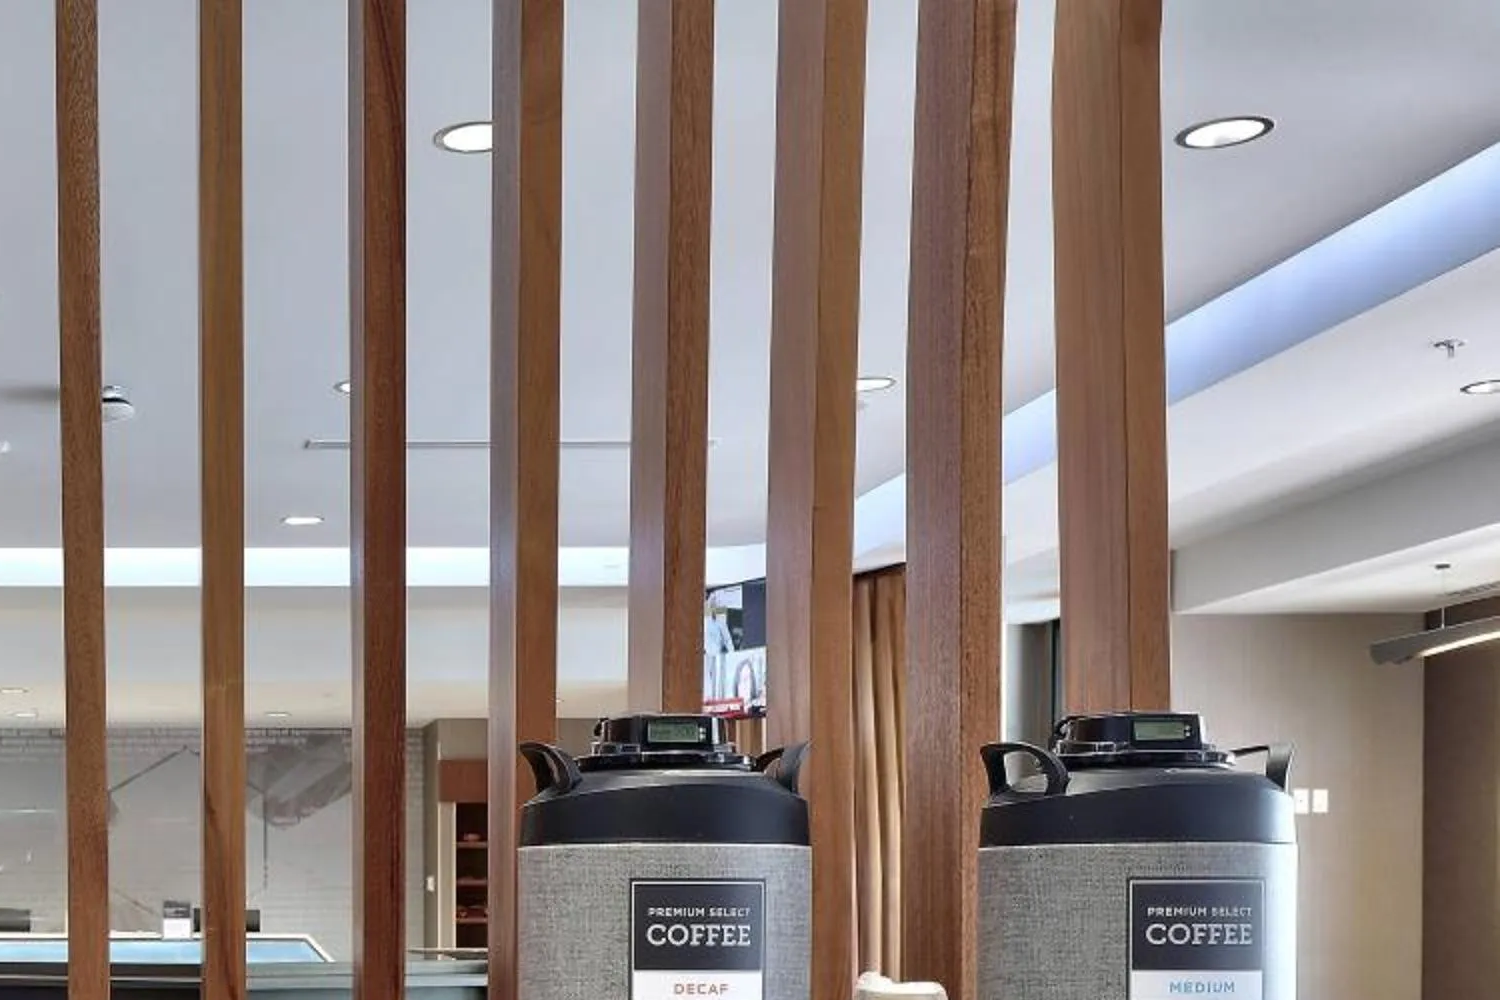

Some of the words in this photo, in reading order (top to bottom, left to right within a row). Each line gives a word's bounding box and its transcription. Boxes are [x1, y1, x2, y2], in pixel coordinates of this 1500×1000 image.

[647, 907, 705, 917] PREMIUM
[709, 907, 750, 917] SELECT
[1147, 907, 1207, 917] PREMIUM
[1211, 907, 1252, 917] SELECT
[646, 924, 751, 946] COFFEE
[1145, 923, 1253, 945] COFFEE
[674, 984, 729, 995] DECAF
[1169, 982, 1235, 993] MEDIUM
